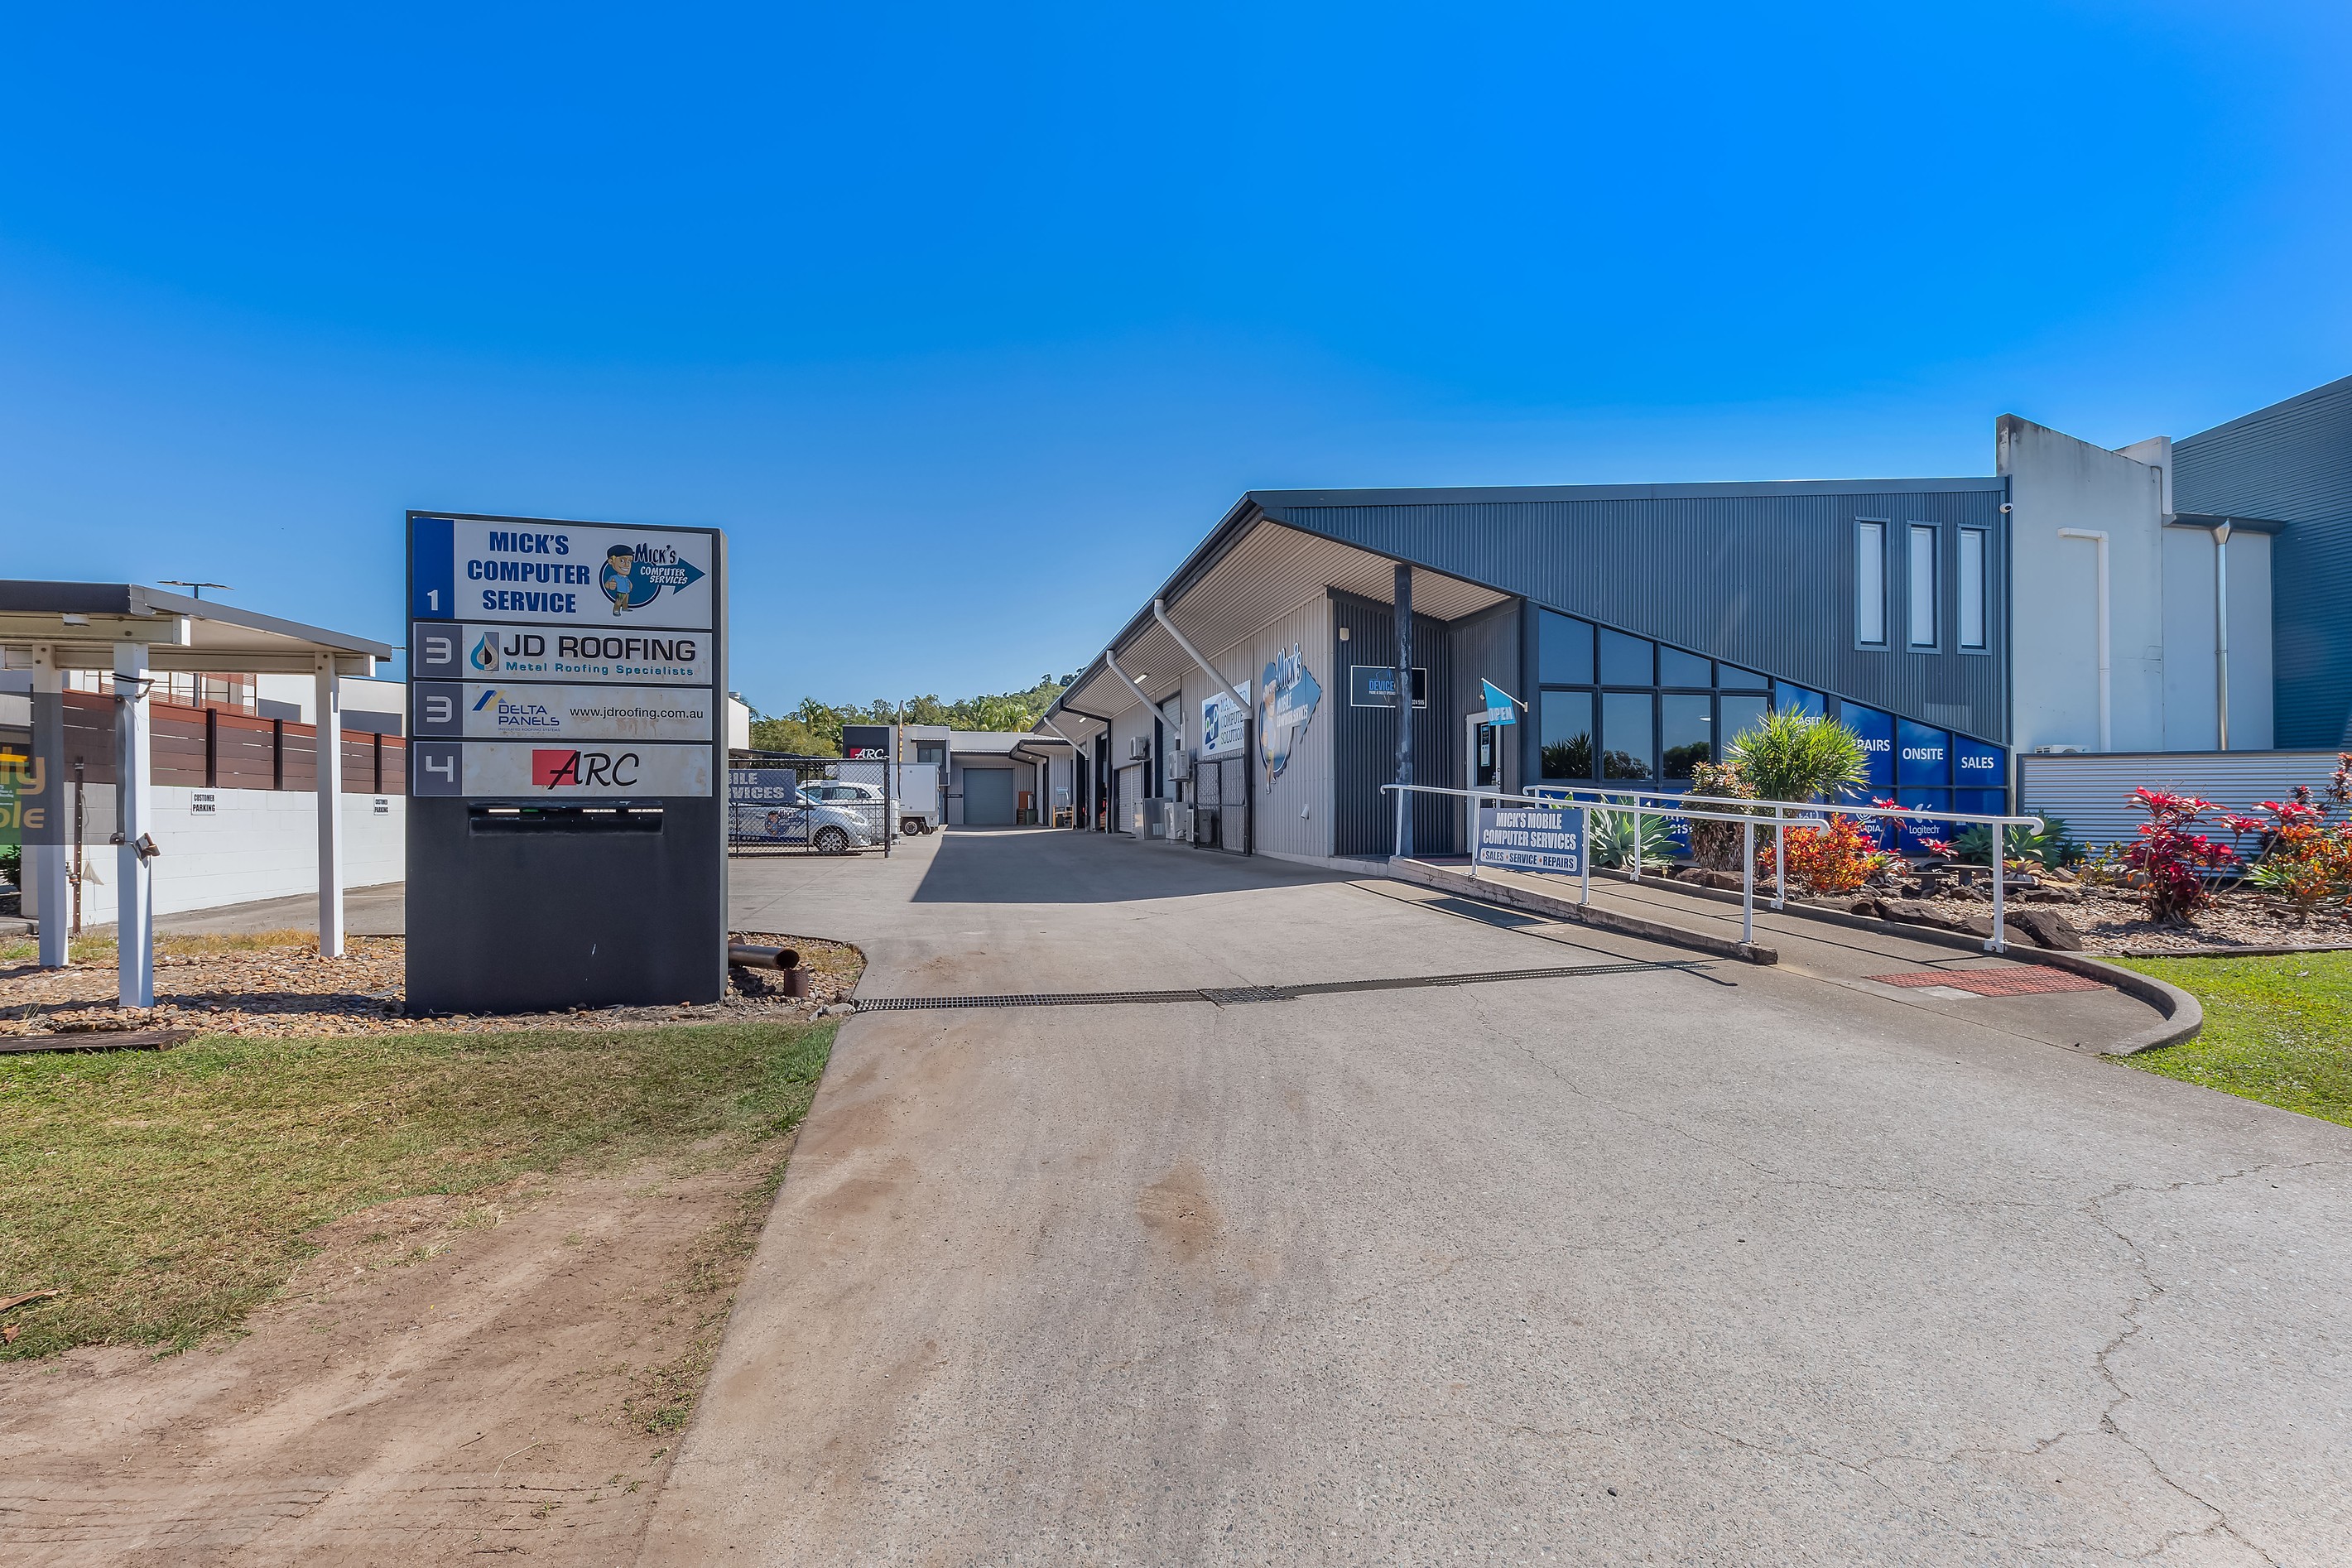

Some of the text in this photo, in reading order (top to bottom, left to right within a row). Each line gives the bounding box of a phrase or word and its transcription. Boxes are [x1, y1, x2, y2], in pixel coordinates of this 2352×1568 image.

[489, 531, 570, 556] MICK'S
[467, 559, 590, 584] COMPUTER
[640, 565, 685, 577] COMPUTER
[649, 575, 688, 584] SERVICES
[426, 589, 439, 611] 1
[482, 589, 577, 613] SERVICE
[426, 637, 452, 664] 3
[503, 633, 696, 661] JD ROOFING
[506, 661, 695, 676] Metal Roofing Specialists
[1368, 680, 1394, 691] DEVICE
[426, 695, 453, 723] 3
[498, 705, 548, 715] DELTA
[570, 707, 704, 719] www.jdroofing.com.au
[1489, 706, 1513, 722] OPEN
[498, 716, 560, 726] PANELS
[854, 748, 884, 760] ARC
[1902, 748, 1944, 760] ONSITE
[426, 756, 454, 782] 4
[546, 751, 640, 790] ARC
[1961, 757, 1994, 769] SALES
[193, 794, 215, 802] CUSTOMER
[192, 804, 216, 812] PARKING
[1496, 812, 1562, 830] MICK'S MOBILE
[1909, 825, 1941, 836] Logitech
[1483, 829, 1576, 851] COMPUTER SERVICES
[1485, 850, 1574, 869] SALES SERVICE REPAIRS
